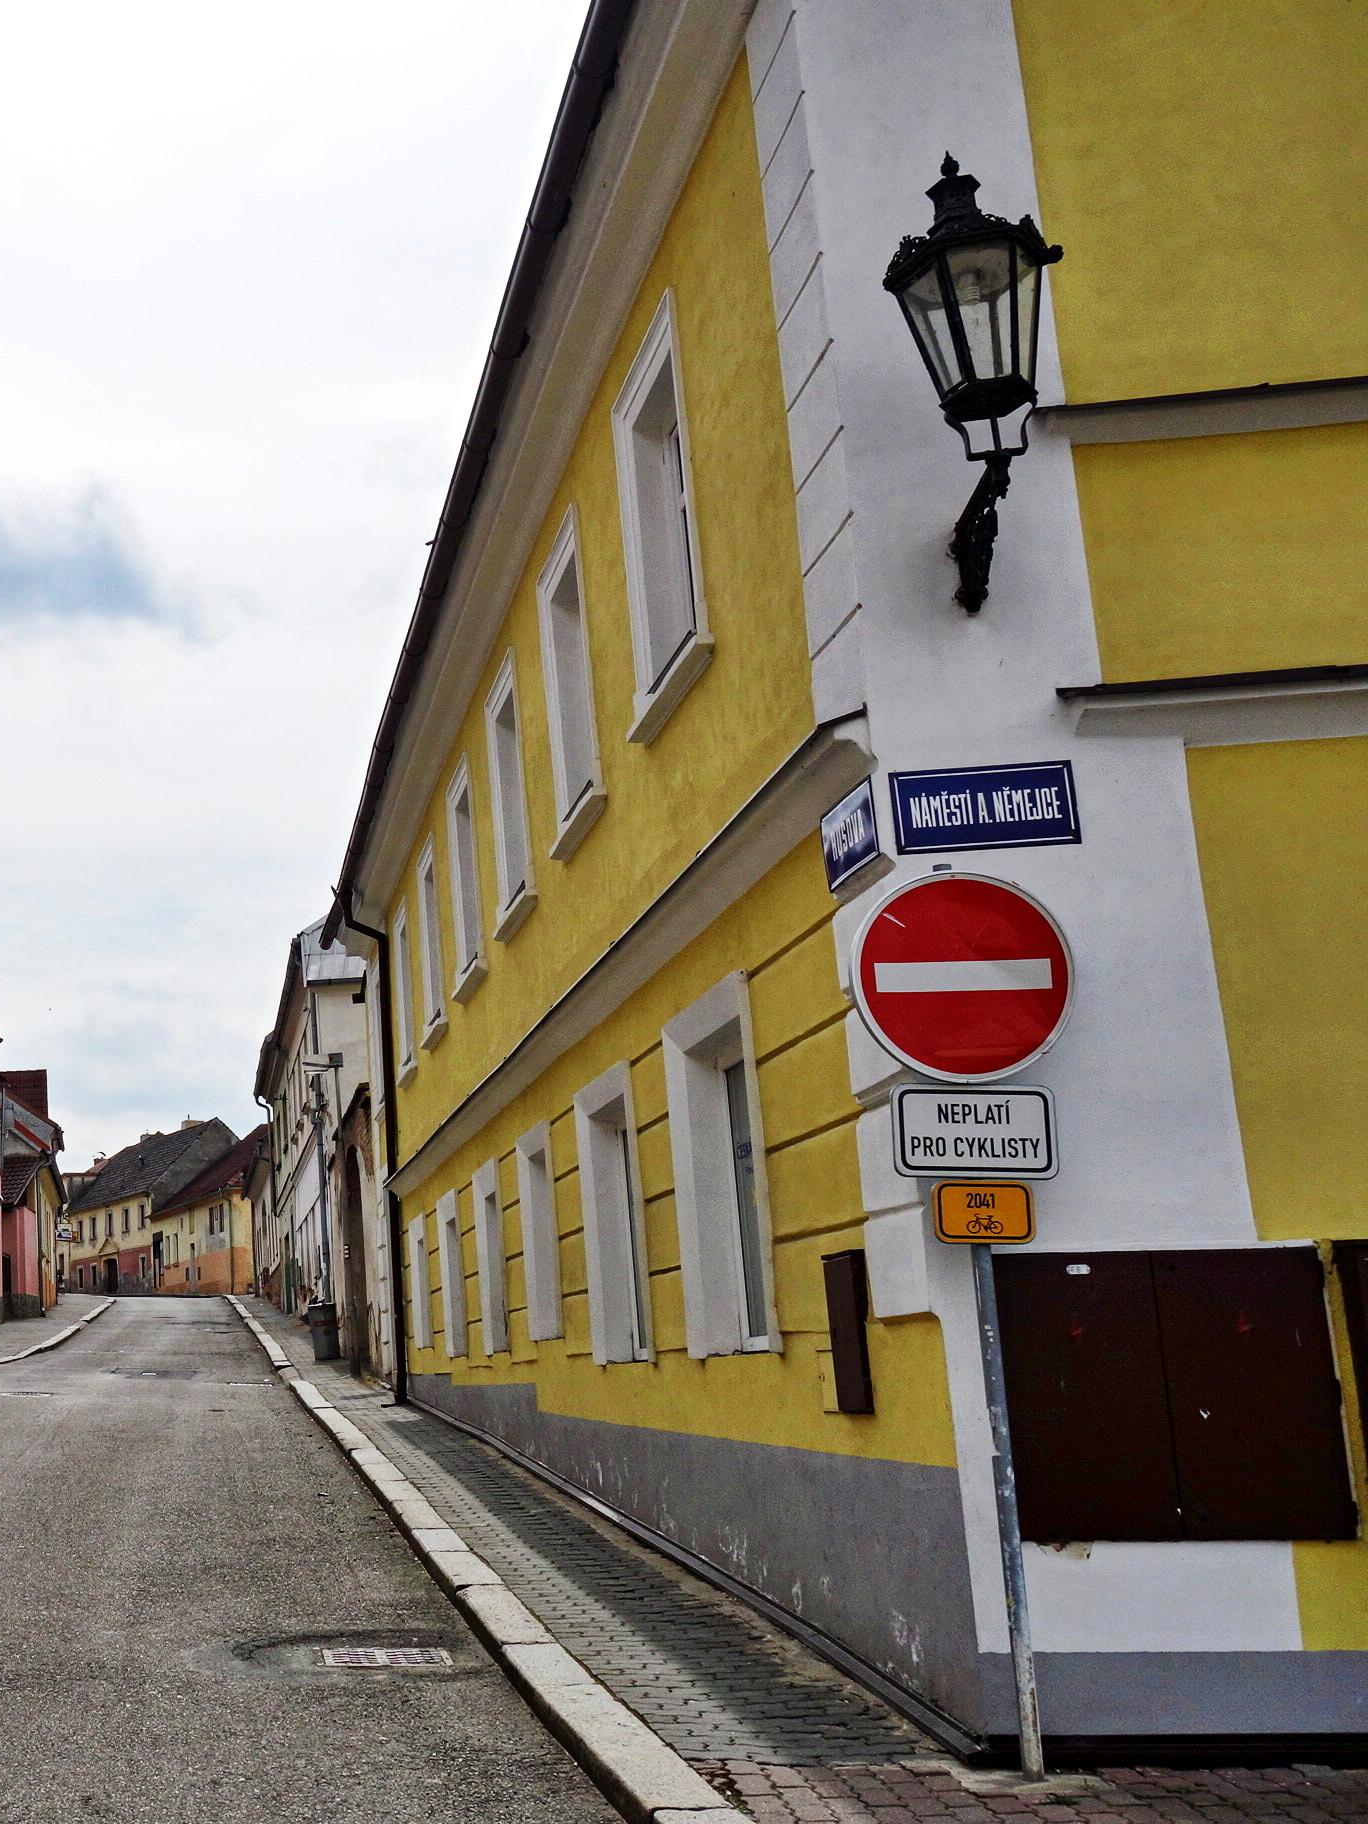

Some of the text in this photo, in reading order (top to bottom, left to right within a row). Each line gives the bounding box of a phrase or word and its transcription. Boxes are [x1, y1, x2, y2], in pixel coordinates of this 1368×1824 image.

[909, 786, 1063, 829] NÁMĚSTÍ A. NĚMEJCE
[937, 1100, 1011, 1125] NEPLATÍ
[910, 1136, 1041, 1159] PRO CYKLISTY
[966, 1192, 996, 1209] 2041
